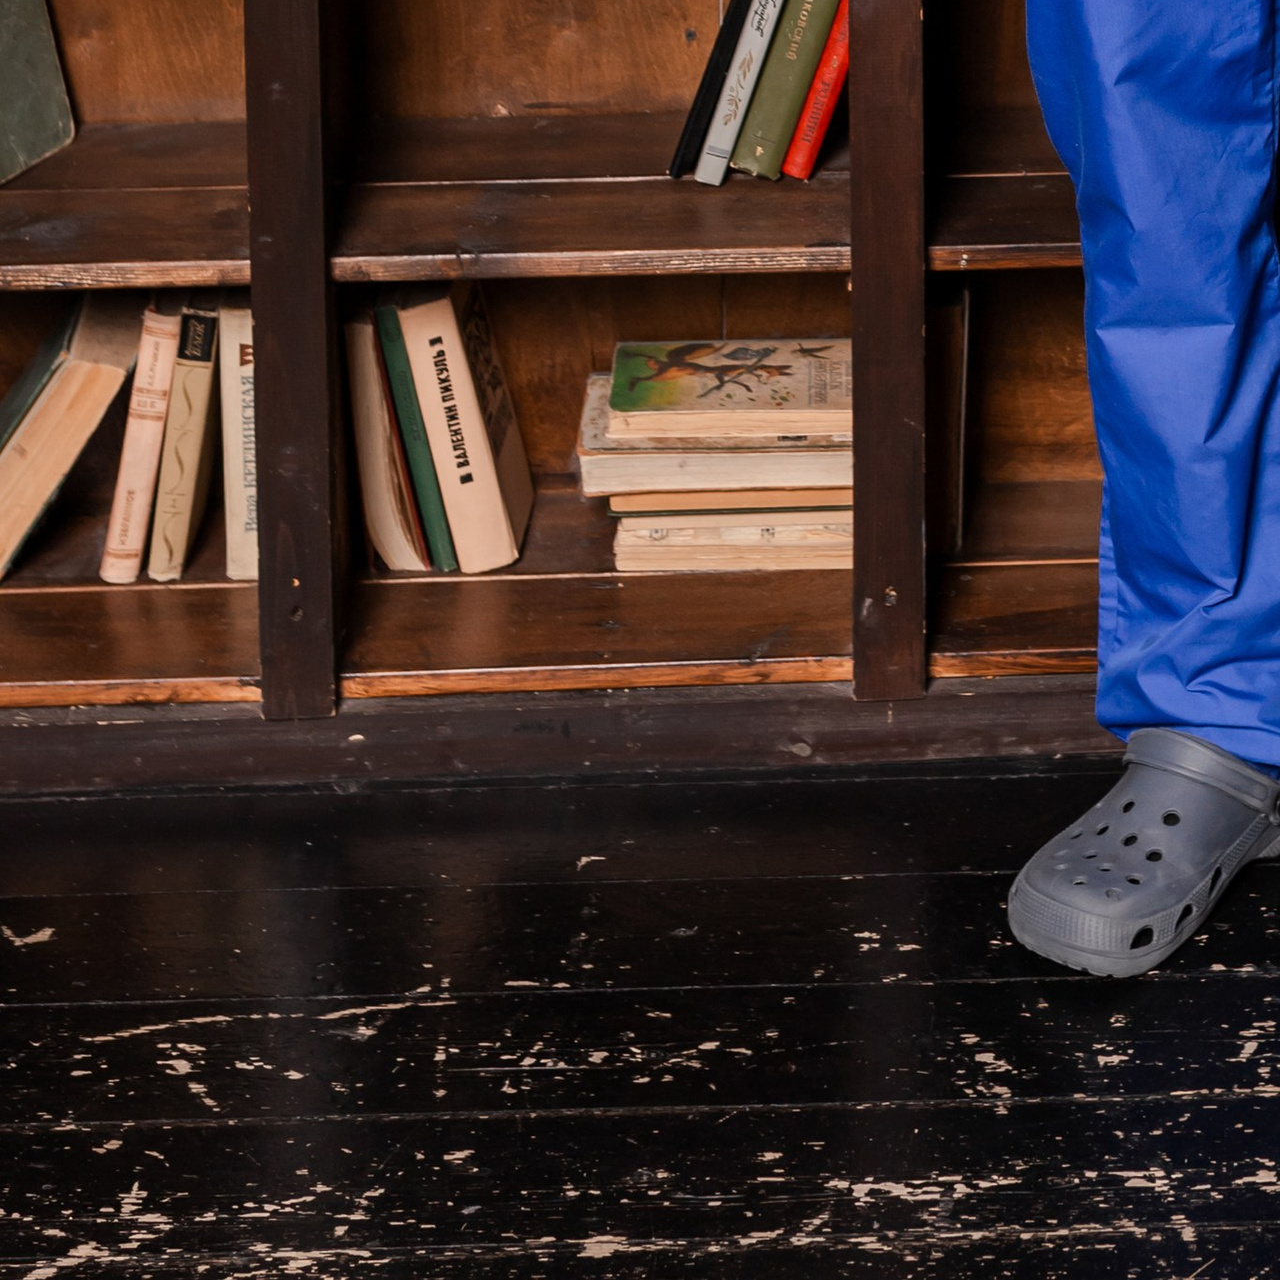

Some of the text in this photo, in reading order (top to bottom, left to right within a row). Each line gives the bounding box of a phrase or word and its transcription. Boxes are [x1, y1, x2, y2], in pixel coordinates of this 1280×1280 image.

[240, 375, 257, 532] Вера КЕТЛИНСКАЯ
[430, 348, 470, 468] ВАЛЕНТИН ПИКУЛЬ
